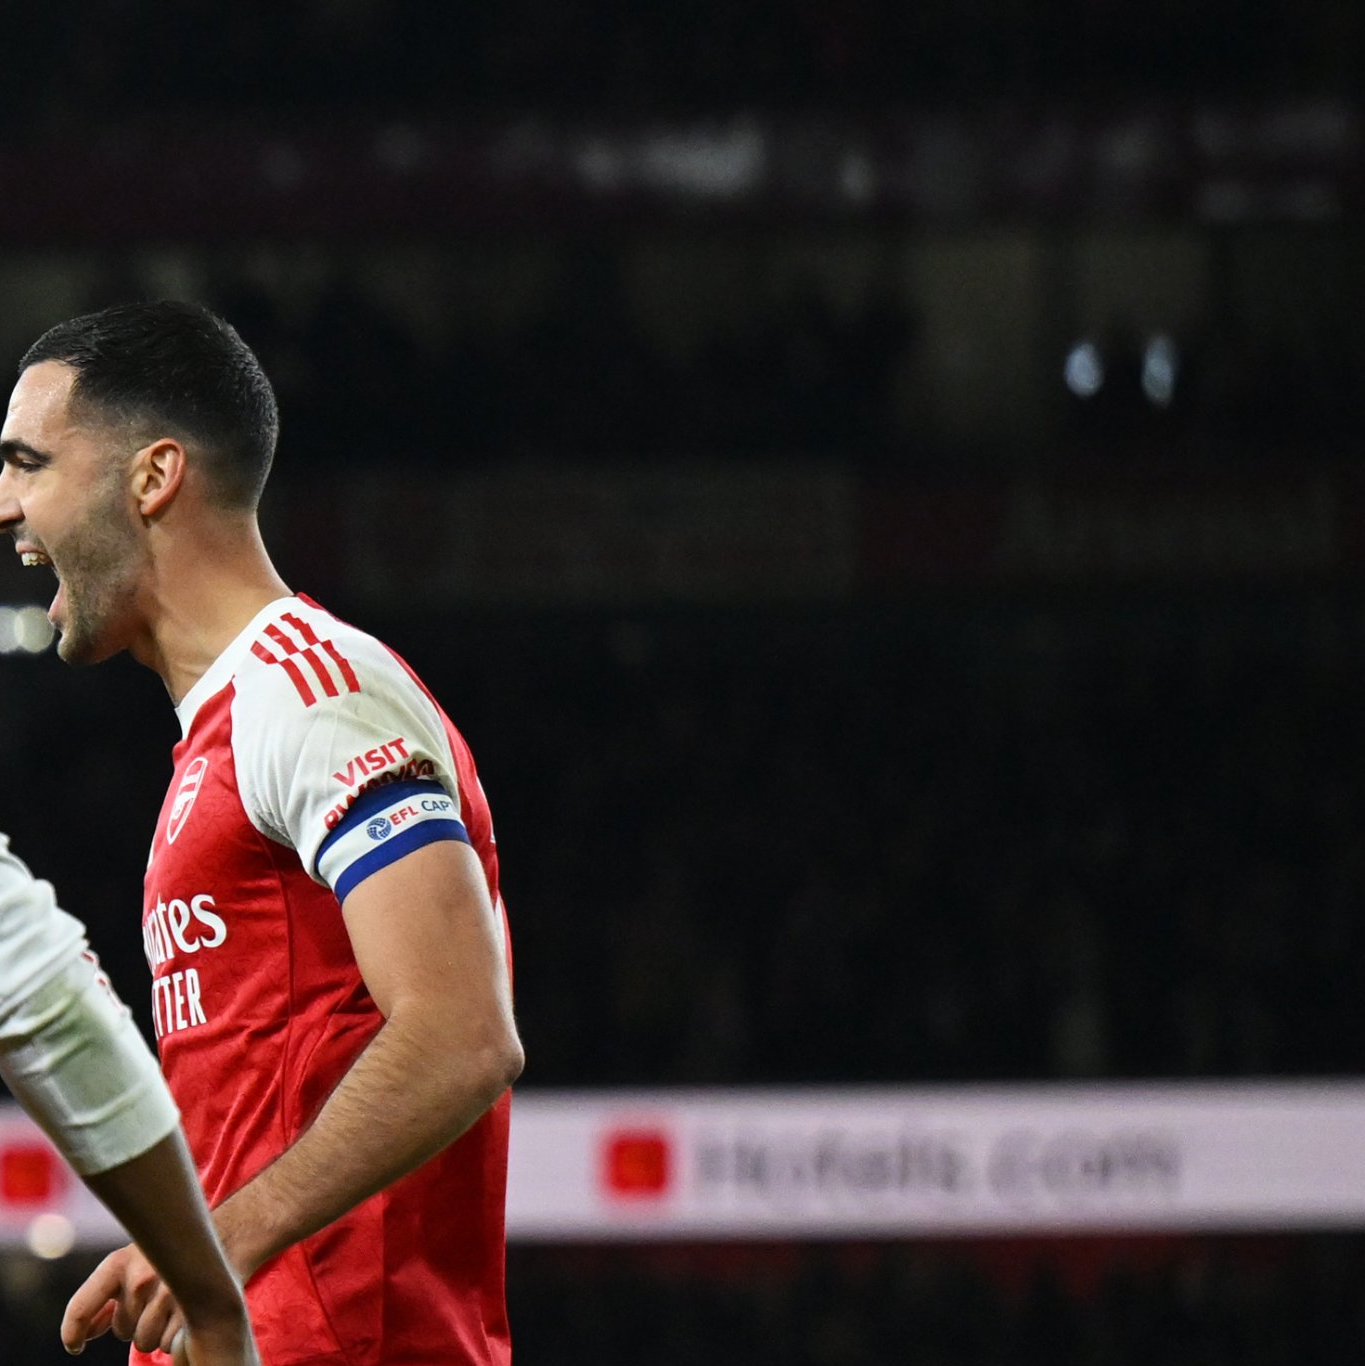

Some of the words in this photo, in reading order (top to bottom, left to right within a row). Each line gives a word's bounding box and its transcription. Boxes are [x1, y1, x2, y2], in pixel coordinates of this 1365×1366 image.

[332, 737, 410, 788] VISIT
[389, 805, 420, 826] EFL
[420, 800, 451, 812] CAP
